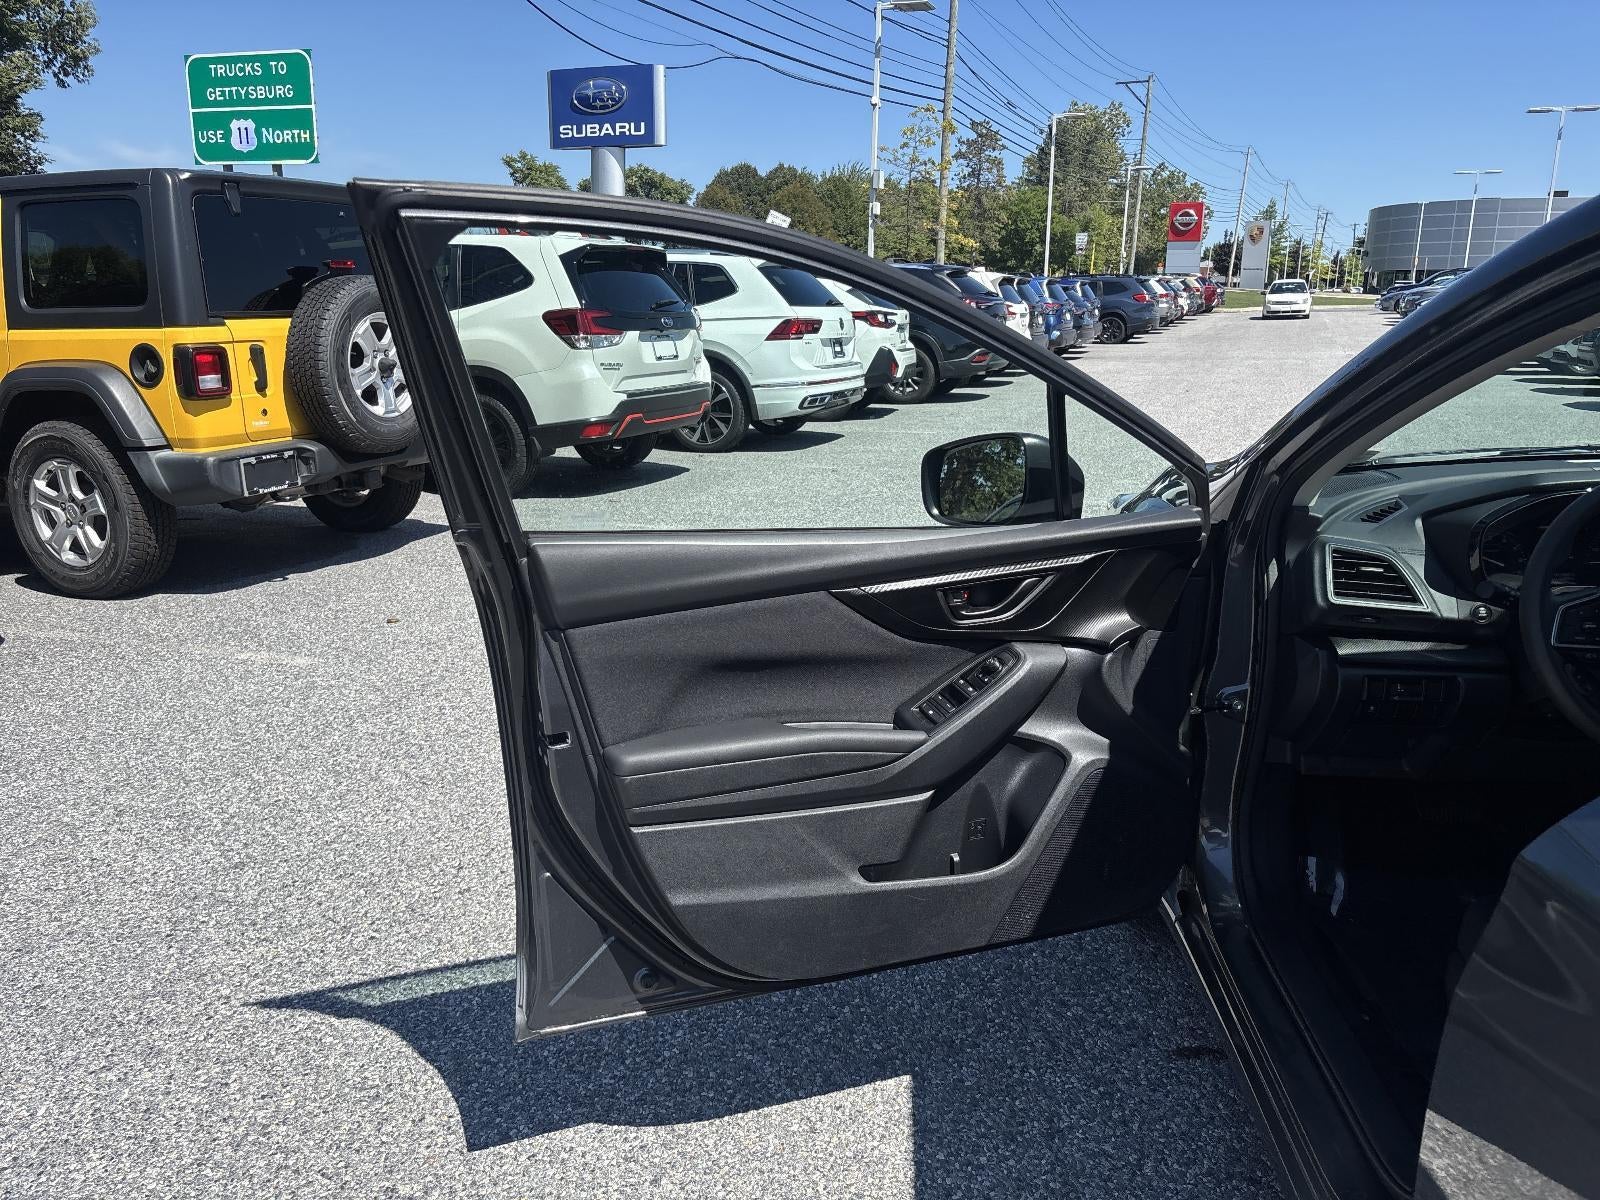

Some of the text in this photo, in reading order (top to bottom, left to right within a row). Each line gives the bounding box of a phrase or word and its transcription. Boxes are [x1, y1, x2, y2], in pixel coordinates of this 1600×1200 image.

[208, 61, 287, 78] TRUCKS TO
[206, 84, 294, 101] GETTYSBURG
[198, 130, 225, 144] USE
[237, 126, 250, 145] 11
[559, 121, 645, 138] SUBARU
